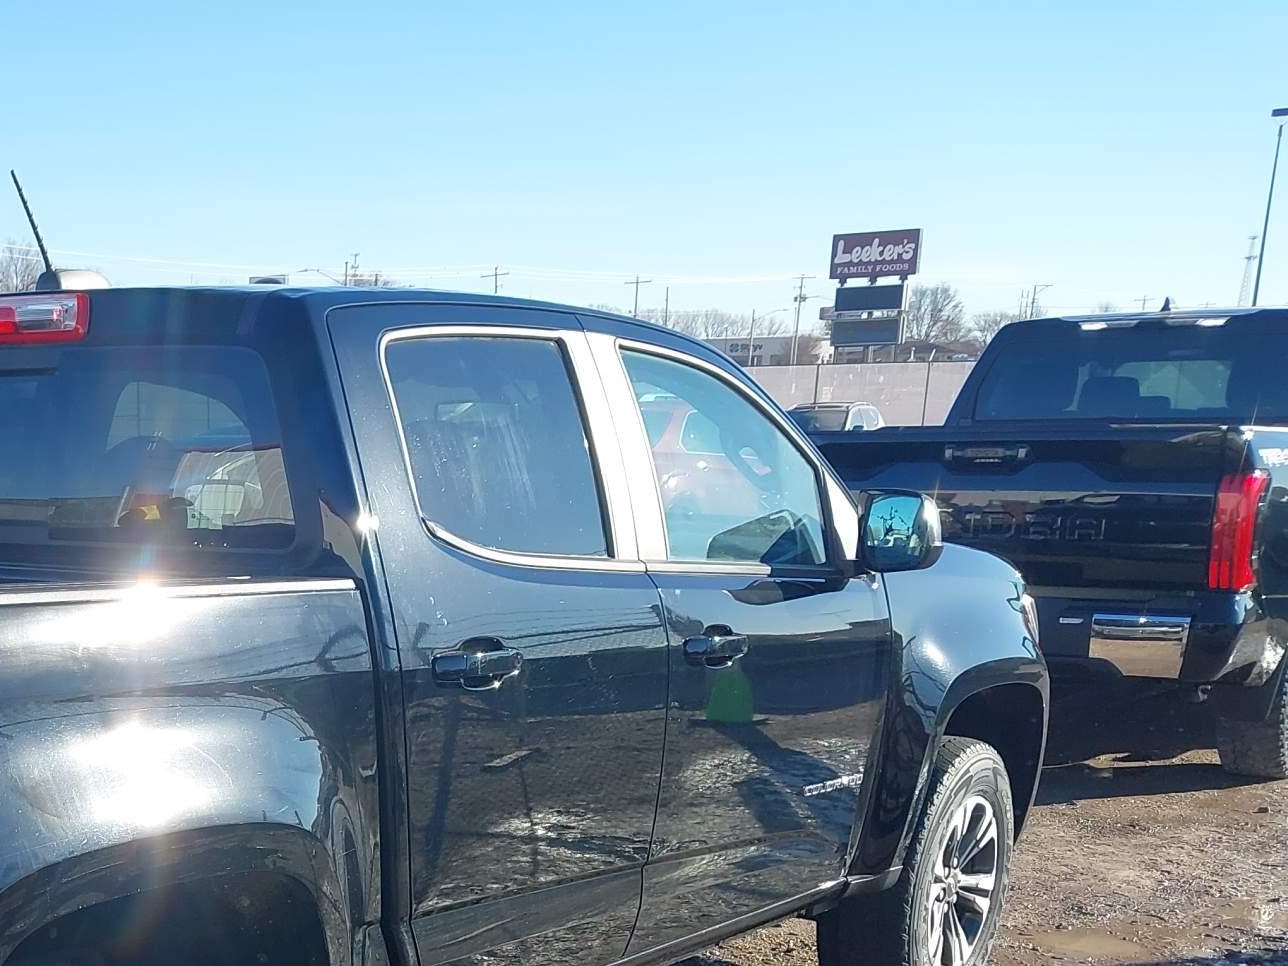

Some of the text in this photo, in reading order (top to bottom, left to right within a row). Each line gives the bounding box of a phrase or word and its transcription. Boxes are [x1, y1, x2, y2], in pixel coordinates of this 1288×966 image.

[834, 238, 916, 264] Leeker's
[836, 263, 910, 274] FAMILY FOODS
[803, 773, 864, 797] COLORADO
